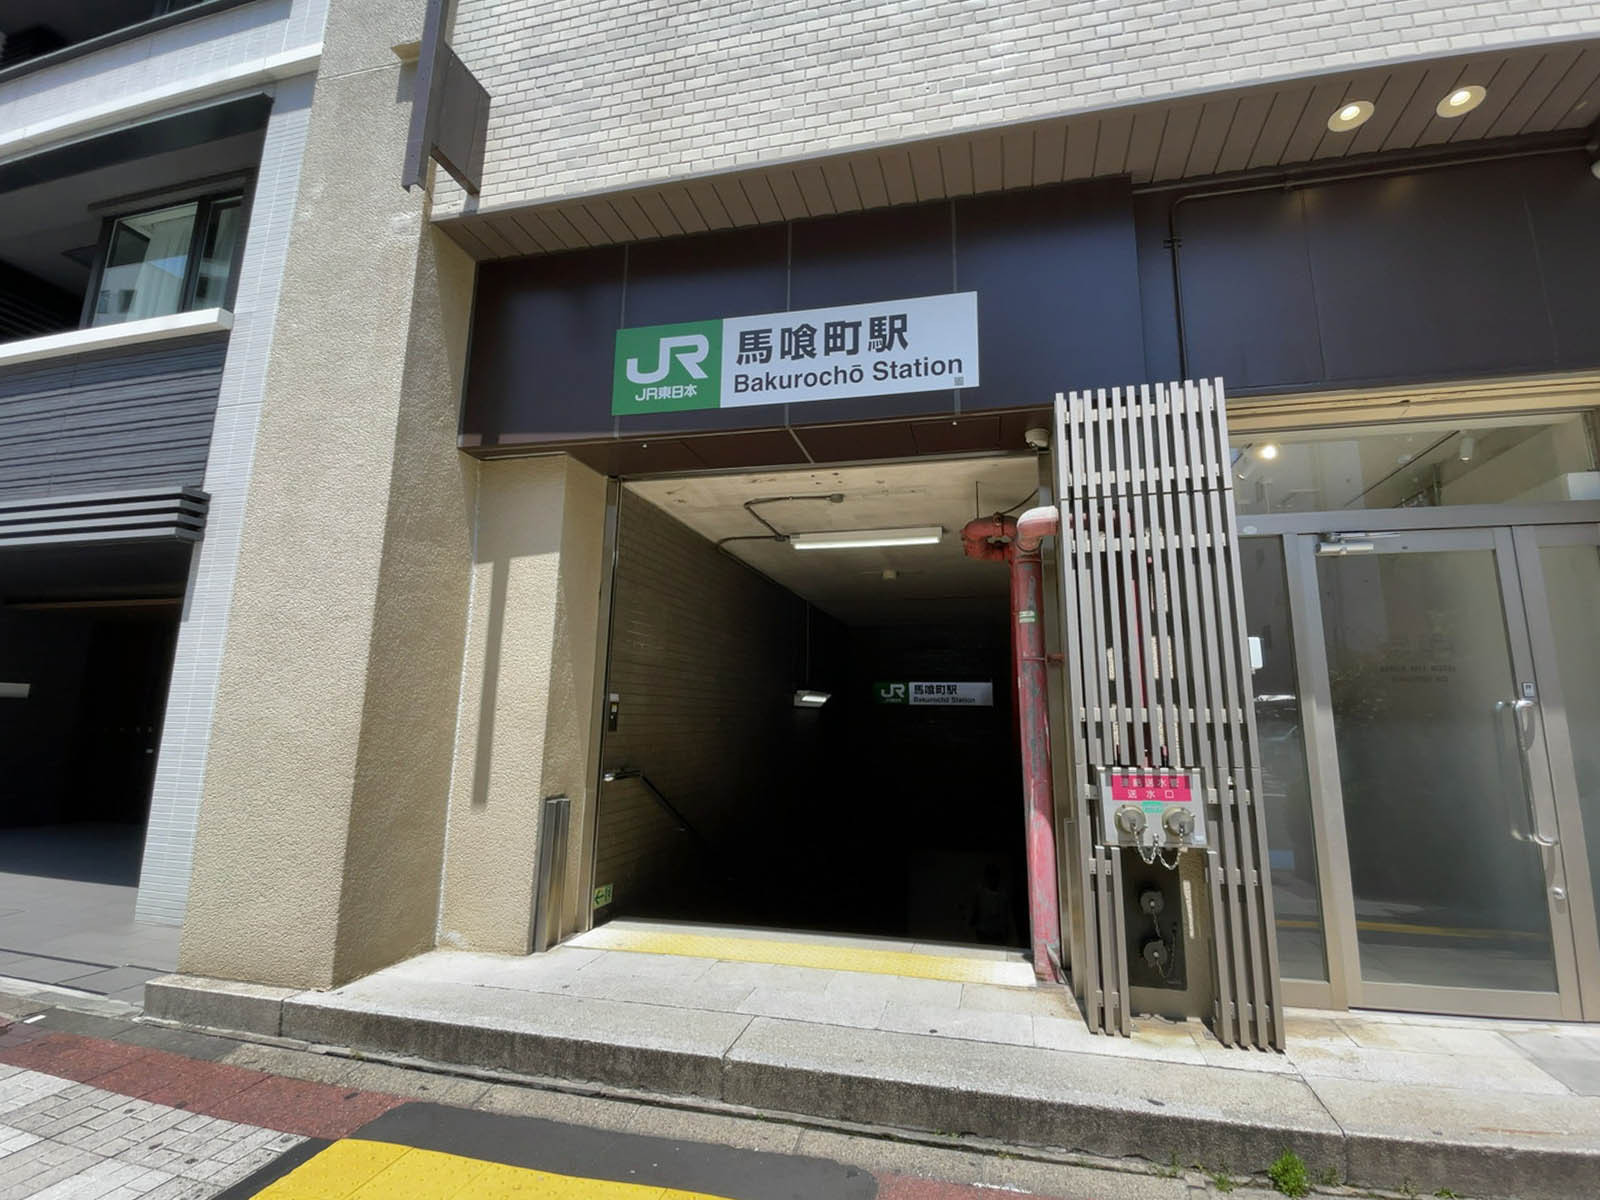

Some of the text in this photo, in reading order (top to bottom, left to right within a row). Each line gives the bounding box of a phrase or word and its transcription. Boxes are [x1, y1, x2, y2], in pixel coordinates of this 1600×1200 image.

[736, 313, 909, 366] 馬喰町駅
[626, 334, 710, 384] JR
[734, 356, 963, 393] Bakurochō Station
[635, 384, 697, 401] JR東日本
[880, 683, 905, 698] JR
